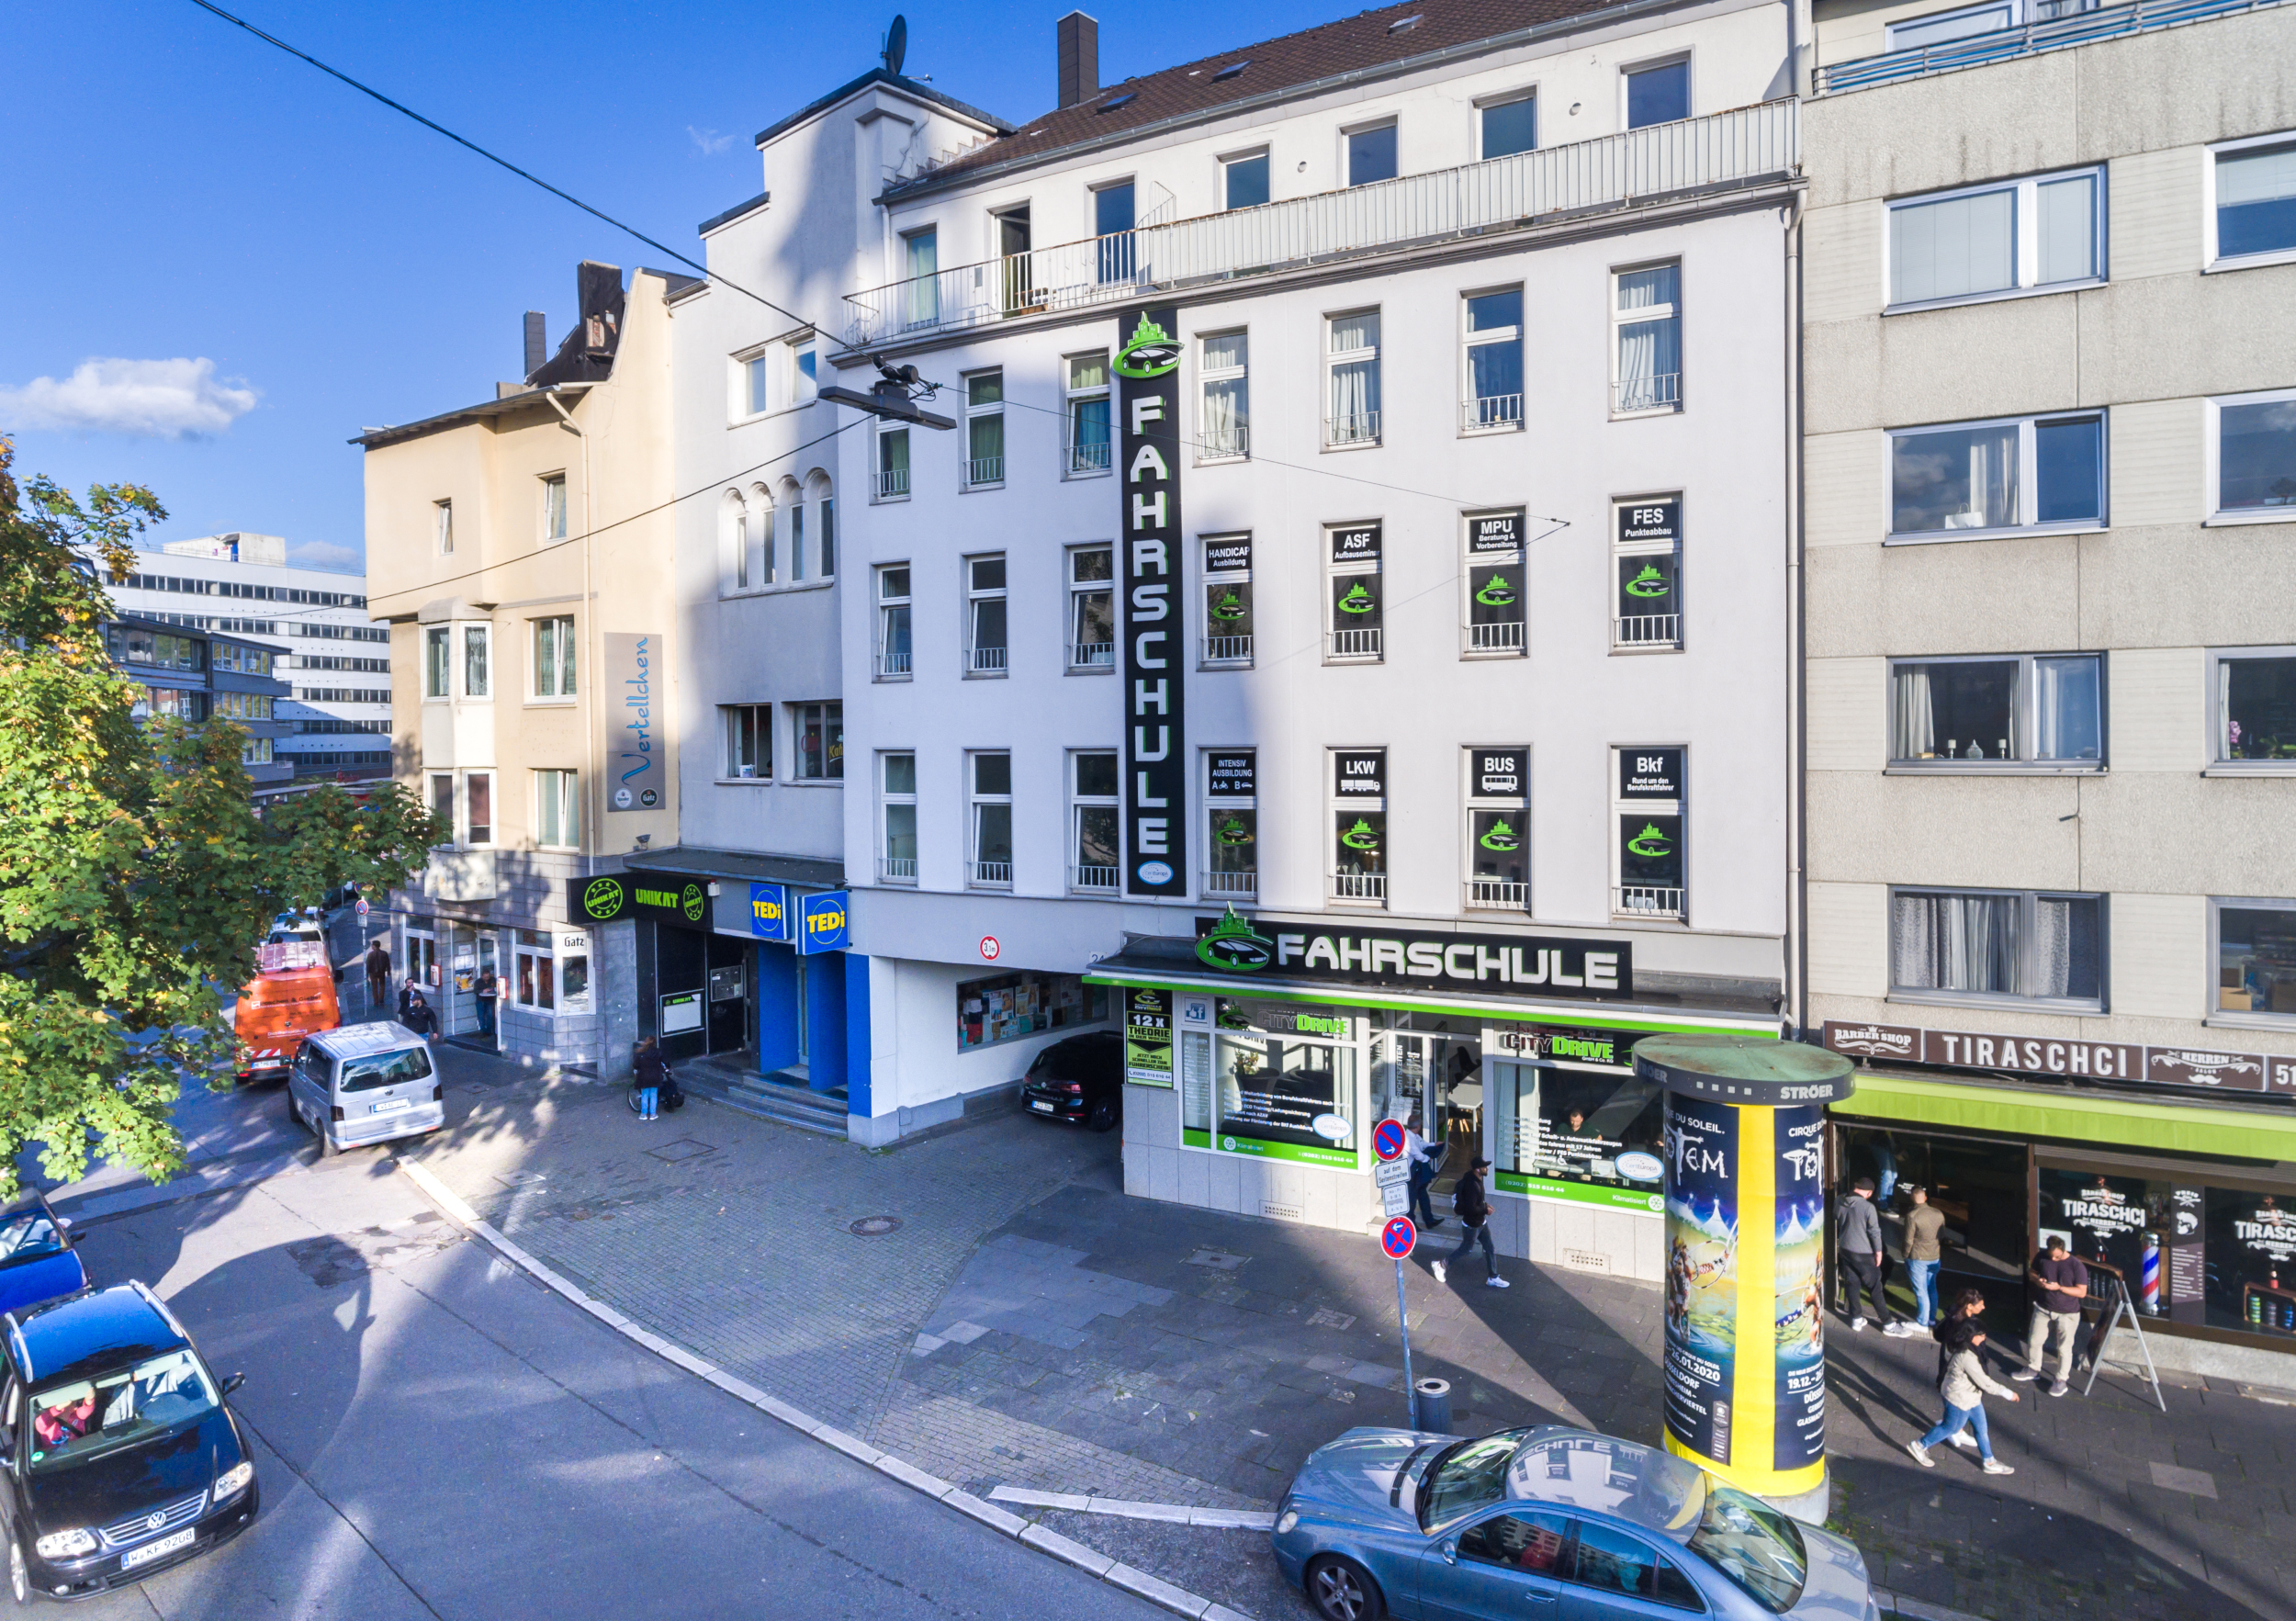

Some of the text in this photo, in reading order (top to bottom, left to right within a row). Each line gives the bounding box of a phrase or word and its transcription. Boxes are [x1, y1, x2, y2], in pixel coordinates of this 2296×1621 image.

[1634, 508, 1663, 524] FES
[1481, 520, 1513, 534] MPU
[1625, 527, 1671, 537] Punkteabbau
[1344, 534, 1370, 548] ASF
[1209, 546, 1250, 558] HANDICAP
[1334, 549, 1379, 559] Aufbauseminar
[1213, 558, 1246, 567] Ausbildung
[1131, 396, 1170, 855] FAHRSCHULE
[621, 637, 651, 786] Vertellchen
[1345, 760, 1375, 774] LKW
[1485, 758, 1514, 772] BUS
[1638, 757, 1663, 772] Bkf
[1212, 781, 1240, 790] A B
[588, 889, 619, 907] UNIKAT
[636, 888, 679, 908] UNIKAT
[752, 901, 782, 920] TEDi
[806, 910, 845, 933] TEDi
[564, 936, 585, 947] Gatz
[1277, 933, 1619, 989] FAHRSCHULE
[1133, 1014, 1153, 1027] 12
[1128, 1026, 1170, 1038] THEORIE
[1834, 1028, 1911, 1046] BARBER SHOP
[1506, 1033, 1614, 1059] CITYDRIVE
[1942, 1034, 2127, 1077] TIRASCHCI
[2181, 1051, 2230, 1064] HERREN
[1675, 1112, 1686, 1124] DU
[1788, 1124, 1817, 1138] CIRQUE
[1612, 1194, 1647, 1206] Klimatisiert
[2062, 1199, 2145, 1228] TIRASCHCI
[2234, 1221, 2296, 1242] TIRASC
[130, 1552, 138, 1561] W
[147, 1543, 161, 1556] KF
